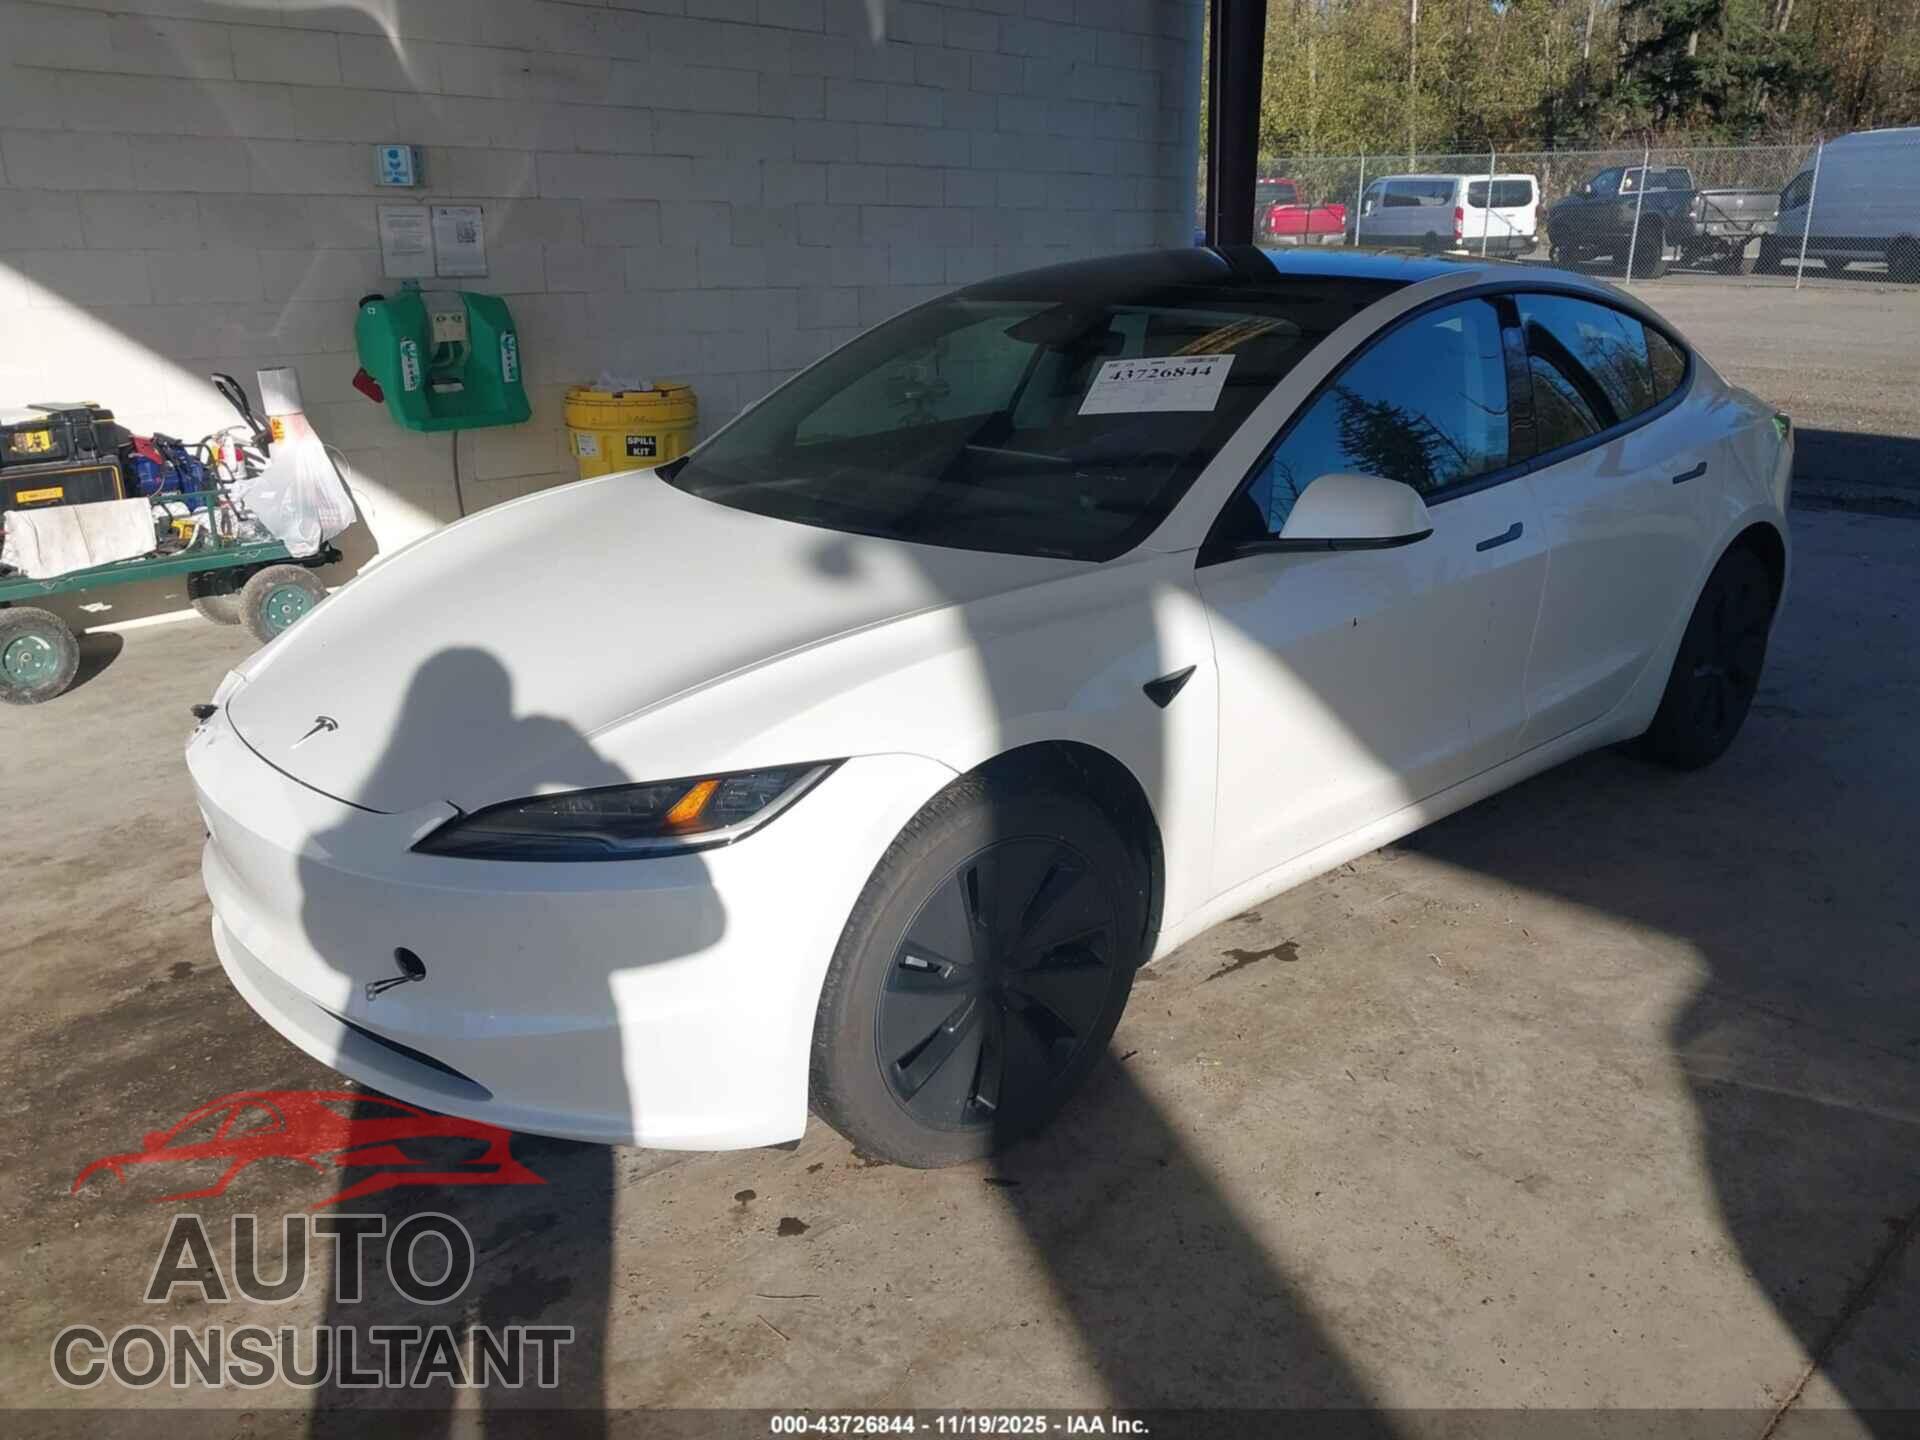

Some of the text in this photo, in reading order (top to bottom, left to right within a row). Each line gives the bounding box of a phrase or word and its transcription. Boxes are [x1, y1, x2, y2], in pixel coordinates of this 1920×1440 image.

[1108, 365, 1213, 380] 43726844
[627, 436, 655, 445] SPILL
[632, 447, 650, 456] KIT
